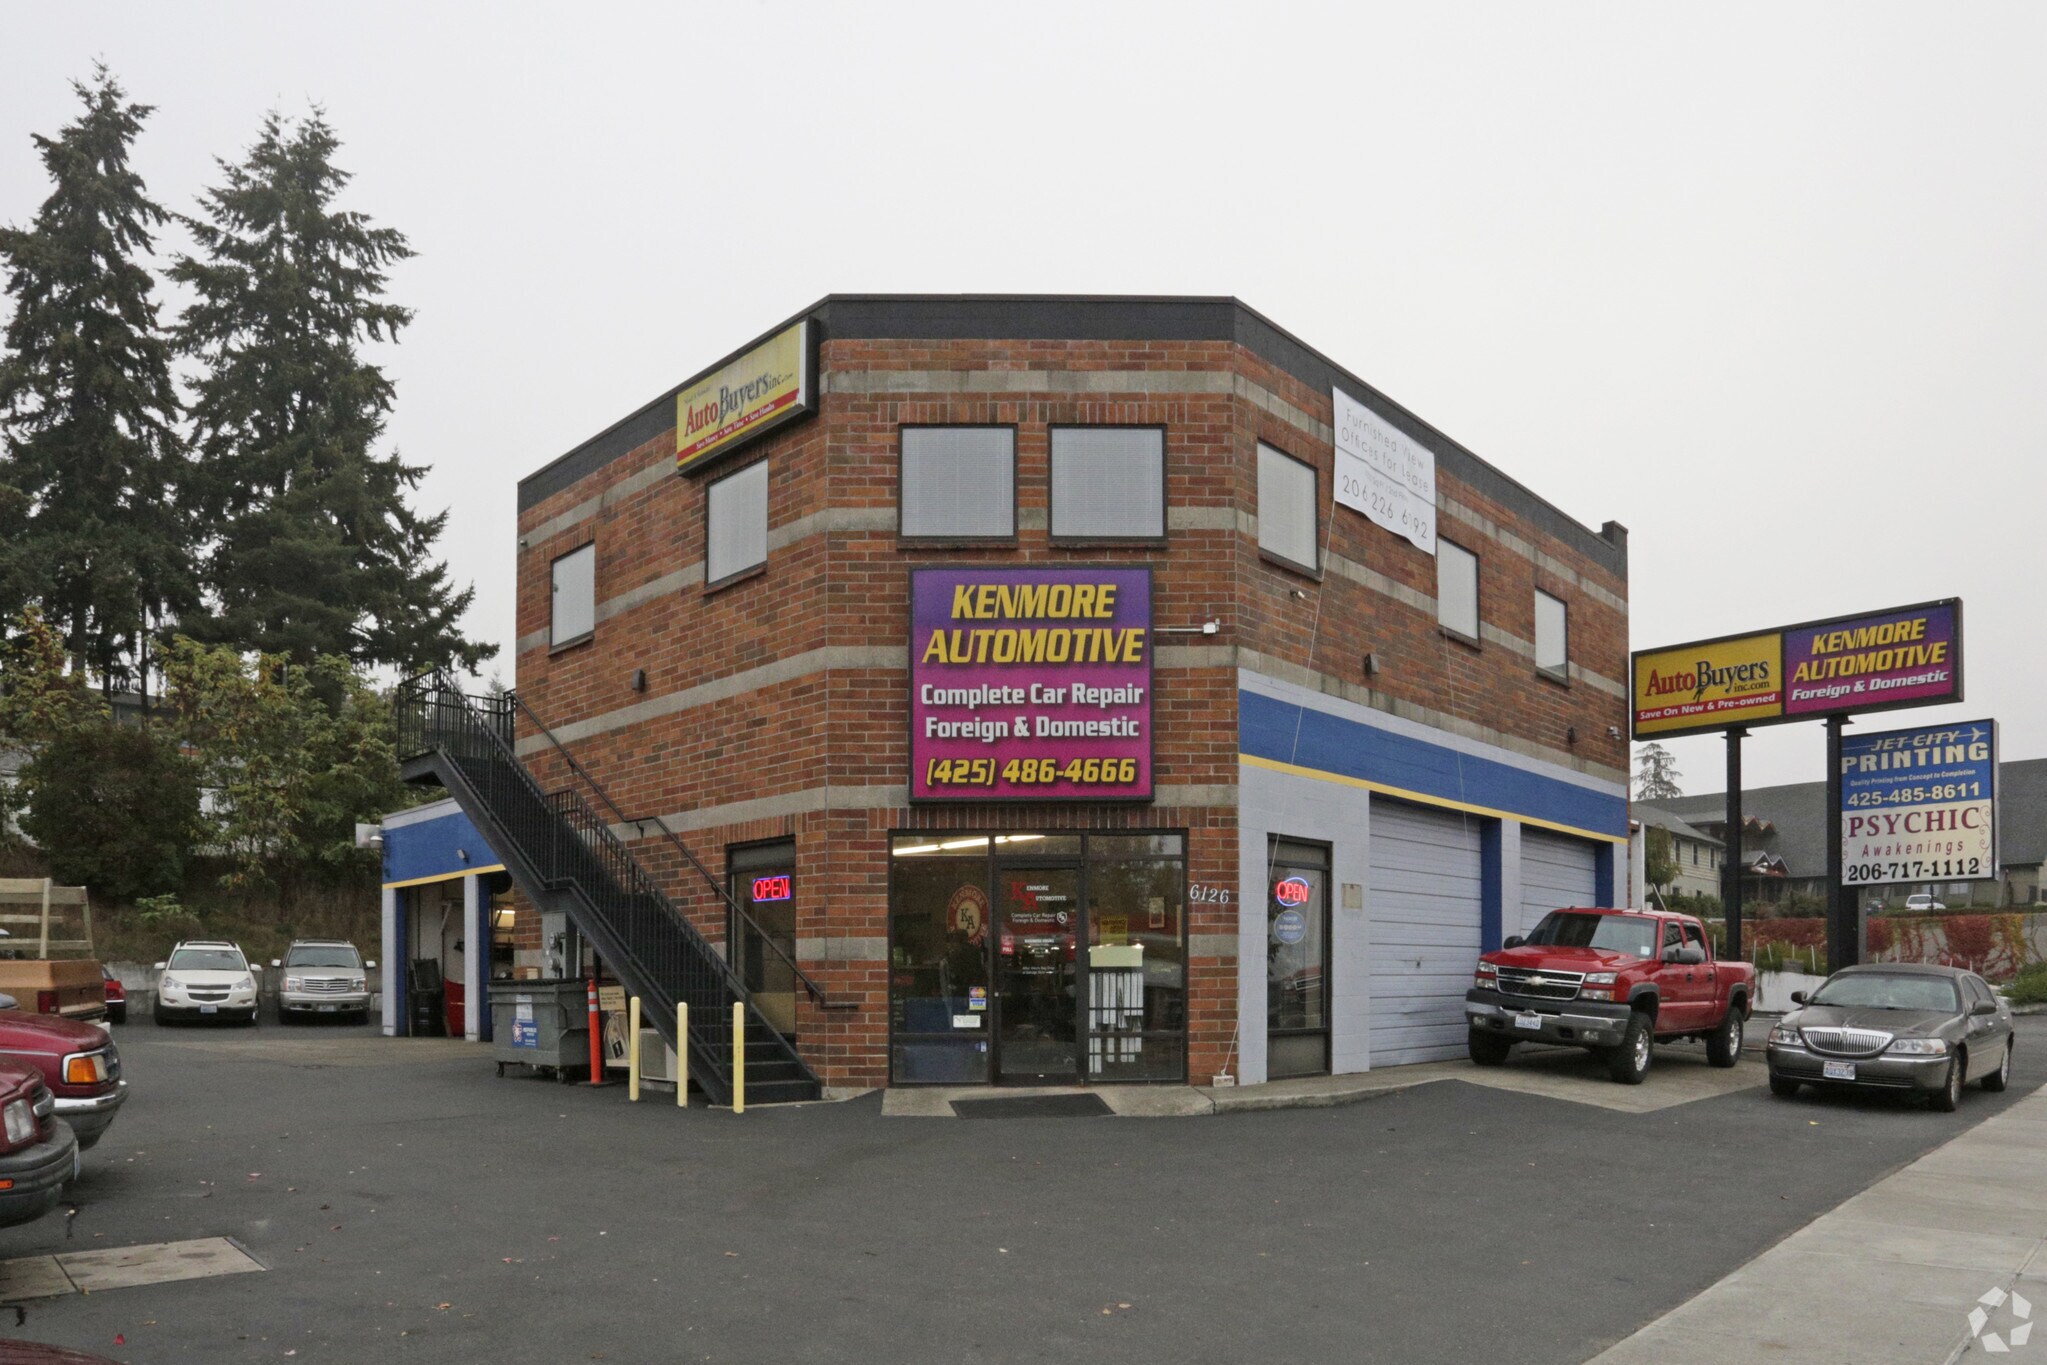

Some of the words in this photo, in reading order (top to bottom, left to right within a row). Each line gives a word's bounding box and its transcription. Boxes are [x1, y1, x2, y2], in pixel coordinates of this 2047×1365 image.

[685, 372, 769, 437] AutoBuyers
[1346, 408, 1397, 452] Furnished
[1341, 427, 1379, 460] Offices
[1382, 453, 1397, 472] for
[1401, 463, 1429, 493] Lease
[1343, 475, 1368, 502] 206
[1371, 492, 1394, 519] 226
[951, 584, 1117, 619] KENMORE
[921, 628, 1145, 663] AUTOMOTIVE
[1811, 618, 1927, 655] KENMORE
[1792, 641, 1948, 682] AUTOMOTIVE
[1645, 660, 1770, 697] AutoBuyers
[1734, 680, 1770, 693] inc.com
[1791, 684, 1850, 701] Foreign
[1853, 680, 1865, 693] &
[1869, 669, 1949, 691] Domestic
[921, 684, 1025, 709] Complete
[1030, 683, 1067, 704] Car
[1071, 683, 1144, 708] Repair
[1640, 710, 1662, 720] Save
[1663, 707, 1678, 717] On
[1681, 704, 1704, 714] New
[1707, 701, 1714, 710] &
[1717, 693, 1776, 709] Pre-owned
[925, 717, 1009, 742] Foreign
[1013, 716, 1030, 737] &
[1035, 715, 1139, 736] Domestic
[1871, 736, 1909, 751] JET
[1912, 730, 1961, 747] CITY
[926, 758, 996, 786] (425)
[1002, 758, 1136, 783] 486-4666
[1841, 742, 1989, 775] PRINTING
[1850, 779, 1870, 787] Quality
[1870, 777, 1894, 785] Printing
[1908, 773, 1934, 781] Concept
[1941, 769, 1976, 779] Completion
[1847, 781, 1981, 807] 425-485-8611
[1848, 806, 1980, 838] PSYCHIC
[1861, 839, 1964, 858] Awakenings
[1848, 857, 1980, 882] 206-717-1112
[754, 877, 790, 900] OPEN
[1190, 884, 1229, 904] 6126
[1276, 881, 1309, 903] OPEN
